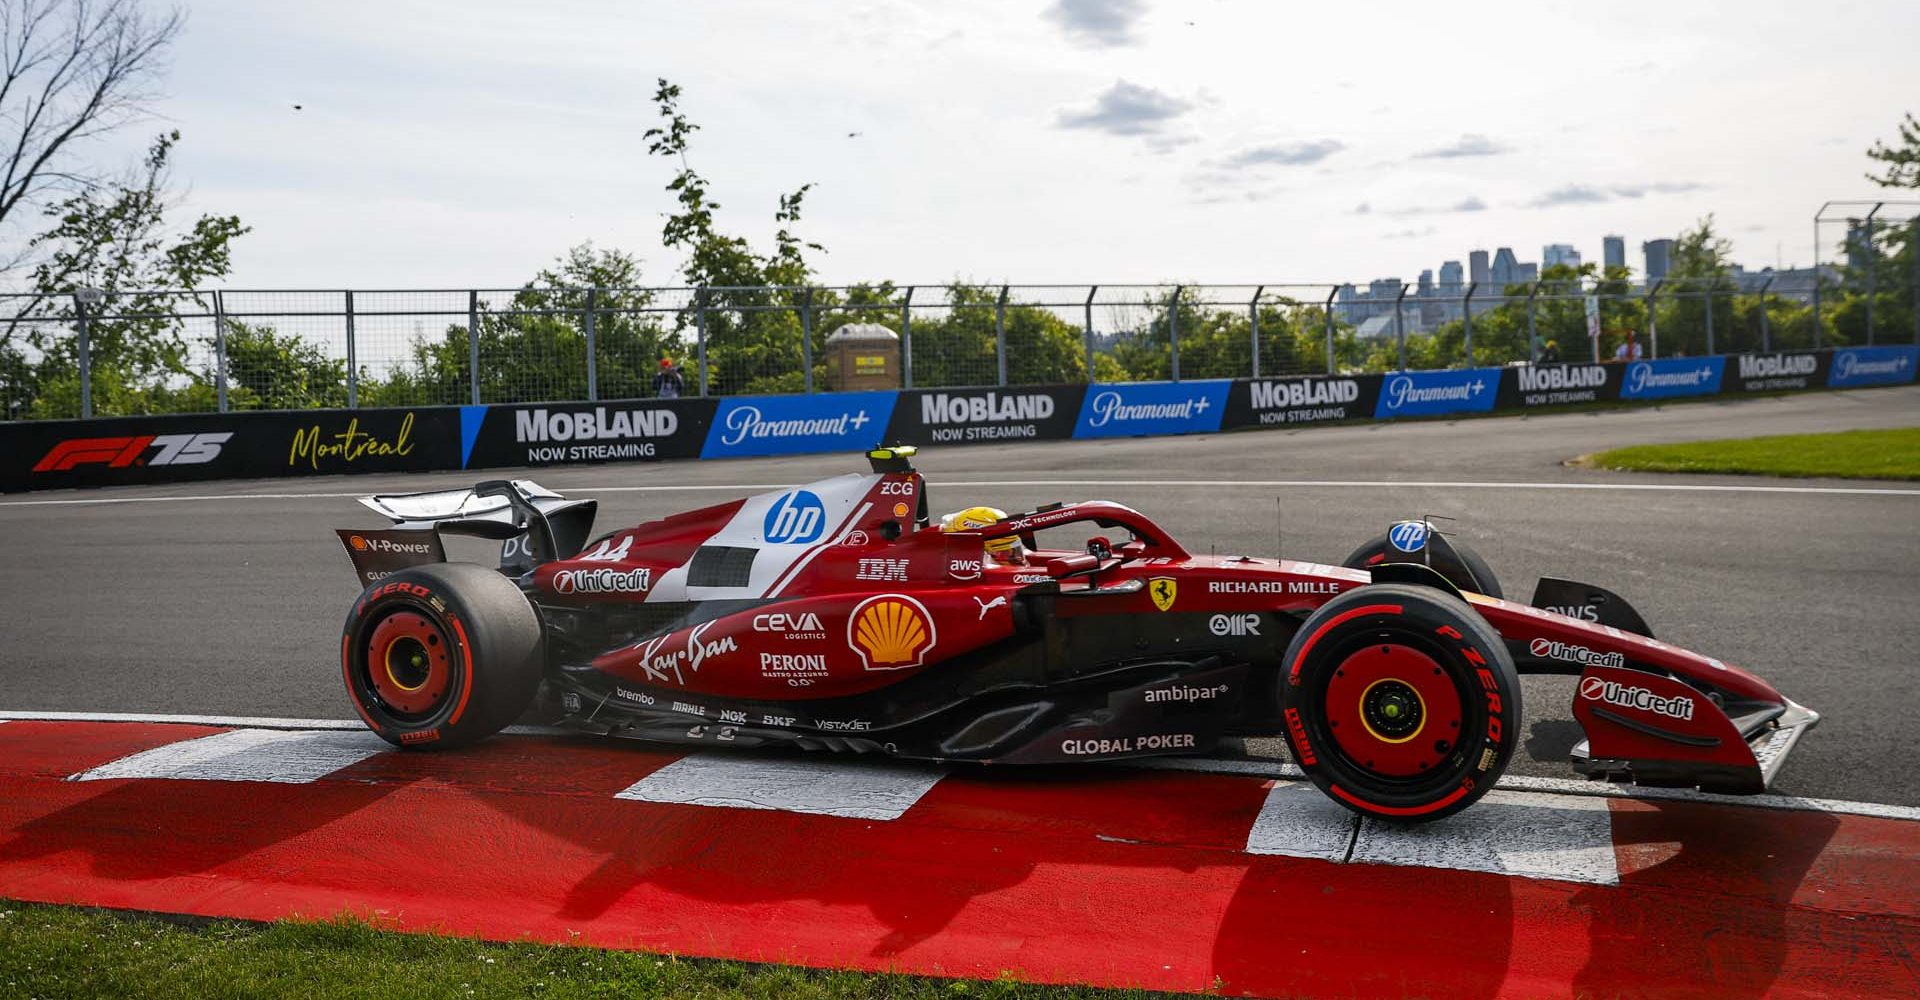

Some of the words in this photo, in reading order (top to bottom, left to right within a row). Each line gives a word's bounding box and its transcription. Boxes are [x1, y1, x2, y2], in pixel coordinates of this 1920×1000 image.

[1628, 363, 1713, 393] Paramount+
[1739, 354, 1817, 378] MOBLAND
[1518, 365, 1607, 392] MOBLAND
[1250, 379, 1359, 409] MOBLAND
[1387, 377, 1486, 410] Paramount+
[920, 391, 1054, 424] MOBLAND
[1089, 391, 1210, 426] Paramount+
[1260, 412, 1286, 424] NOW
[1287, 408, 1345, 422] STREAMING
[516, 406, 679, 443] MOBLAND
[722, 405, 870, 446] Paramount+
[932, 427, 963, 441] NOW
[965, 424, 1036, 440] STREAMING
[289, 411, 415, 470] Montréal
[528, 446, 567, 462] NOW
[570, 443, 656, 460] STREAMING
[880, 481, 913, 496] ZCG
[768, 490, 820, 544] hp
[1009, 518, 1033, 531] DXC
[366, 539, 430, 554] V-Power
[580, 536, 634, 561] 44
[856, 558, 910, 582] IBM
[950, 559, 981, 571] aws
[571, 569, 651, 593] UniCredit
[1209, 581, 1282, 593] RICHARD
[1288, 582, 1340, 594] MILLE
[760, 652, 827, 671] PERONI
[1549, 641, 1625, 669] UniCredit
[616, 685, 656, 706] brembo
[1461, 646, 1503, 743] ZERO
[1604, 681, 1694, 720] UniCredit
[672, 701, 705, 716] MAHLE
[720, 709, 748, 723] NGK
[762, 714, 796, 727] SKF
[1061, 738, 1132, 755] GLOBAL
[1137, 734, 1195, 750] POKER
